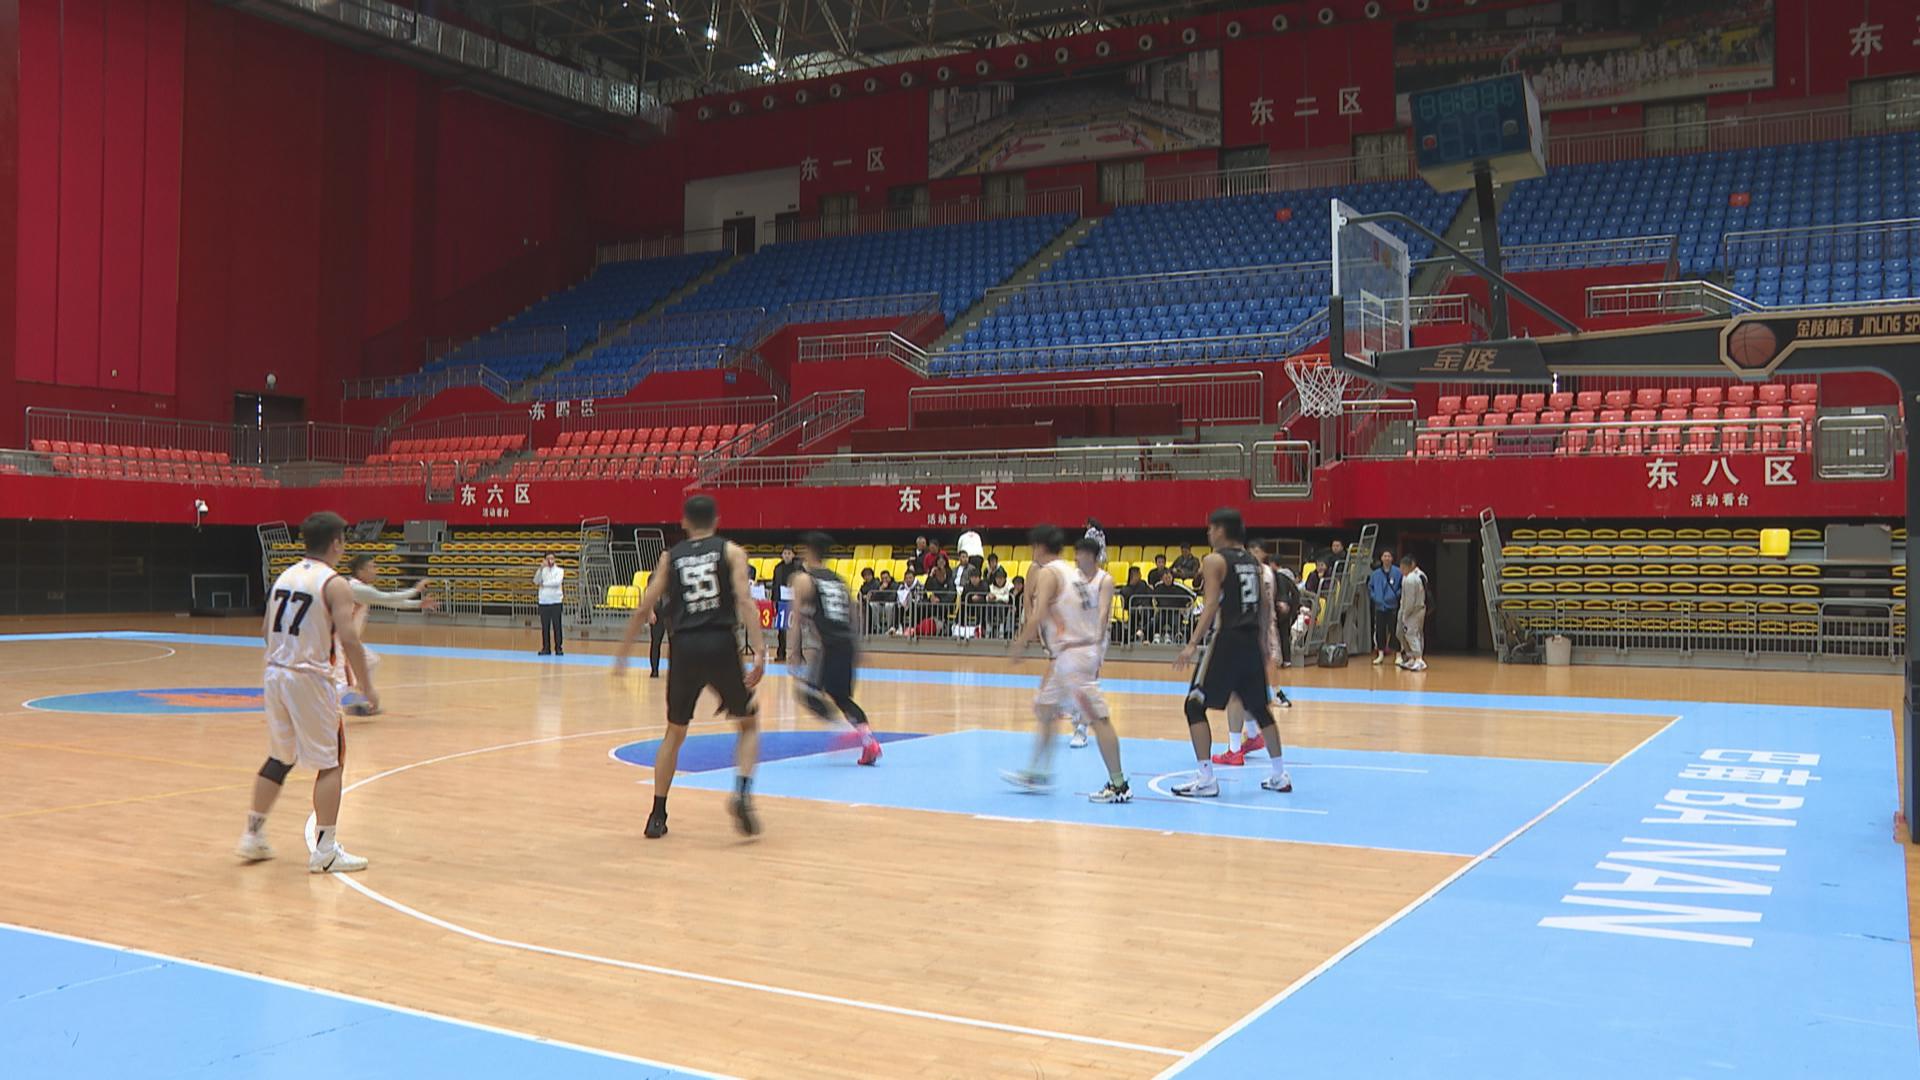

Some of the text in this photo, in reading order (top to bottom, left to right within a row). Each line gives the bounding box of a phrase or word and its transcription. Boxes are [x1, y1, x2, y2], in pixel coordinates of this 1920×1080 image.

[1249, 87, 1362, 125] 东二区
[801, 146, 885, 181] 东一区
[1797, 317, 1854, 337] 金陵体育
[1859, 314, 1900, 335] JINLING
[1434, 348, 1498, 372] 金陵
[530, 399, 595, 421] 东四区
[1646, 456, 1797, 490] 东八区
[461, 484, 531, 506] 东六区
[899, 486, 998, 512] 东七区
[1691, 493, 1749, 508] 活动看台
[927, 513, 968, 525] 活动看台
[681, 562, 720, 602] 55
[273, 589, 313, 636] 77
[1537, 748, 1822, 948] 巴南 BA NAN
